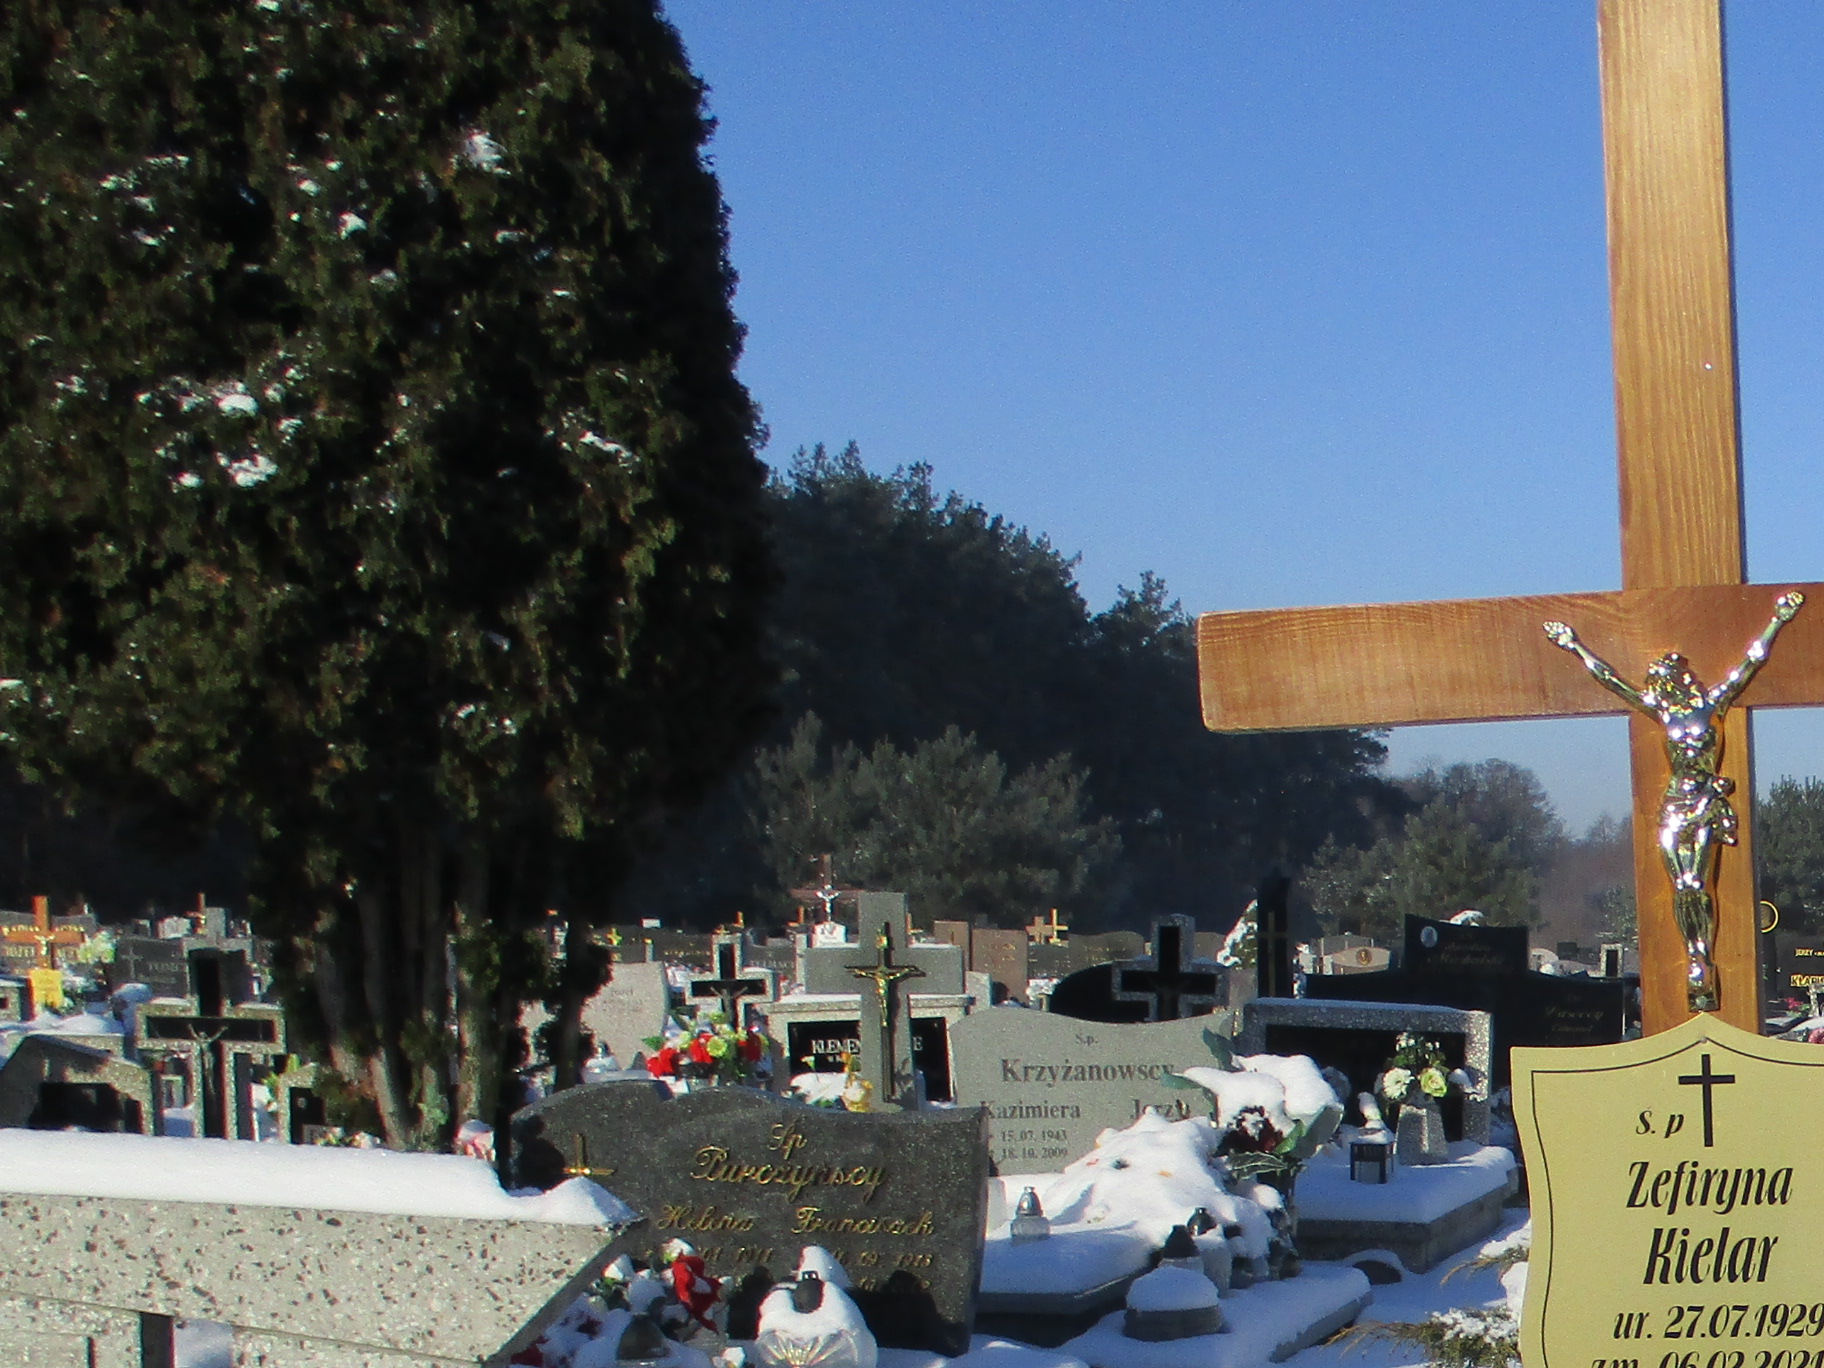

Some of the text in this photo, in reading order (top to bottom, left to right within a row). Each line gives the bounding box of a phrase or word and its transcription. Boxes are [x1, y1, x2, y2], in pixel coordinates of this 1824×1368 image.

[1001, 1058, 1175, 1087] Krzyżanowscy
[1625, 1159, 1794, 1216] Zefiryna
[1643, 1226, 1779, 1285] Kielar
[1613, 1309, 1653, 1340] ur.
